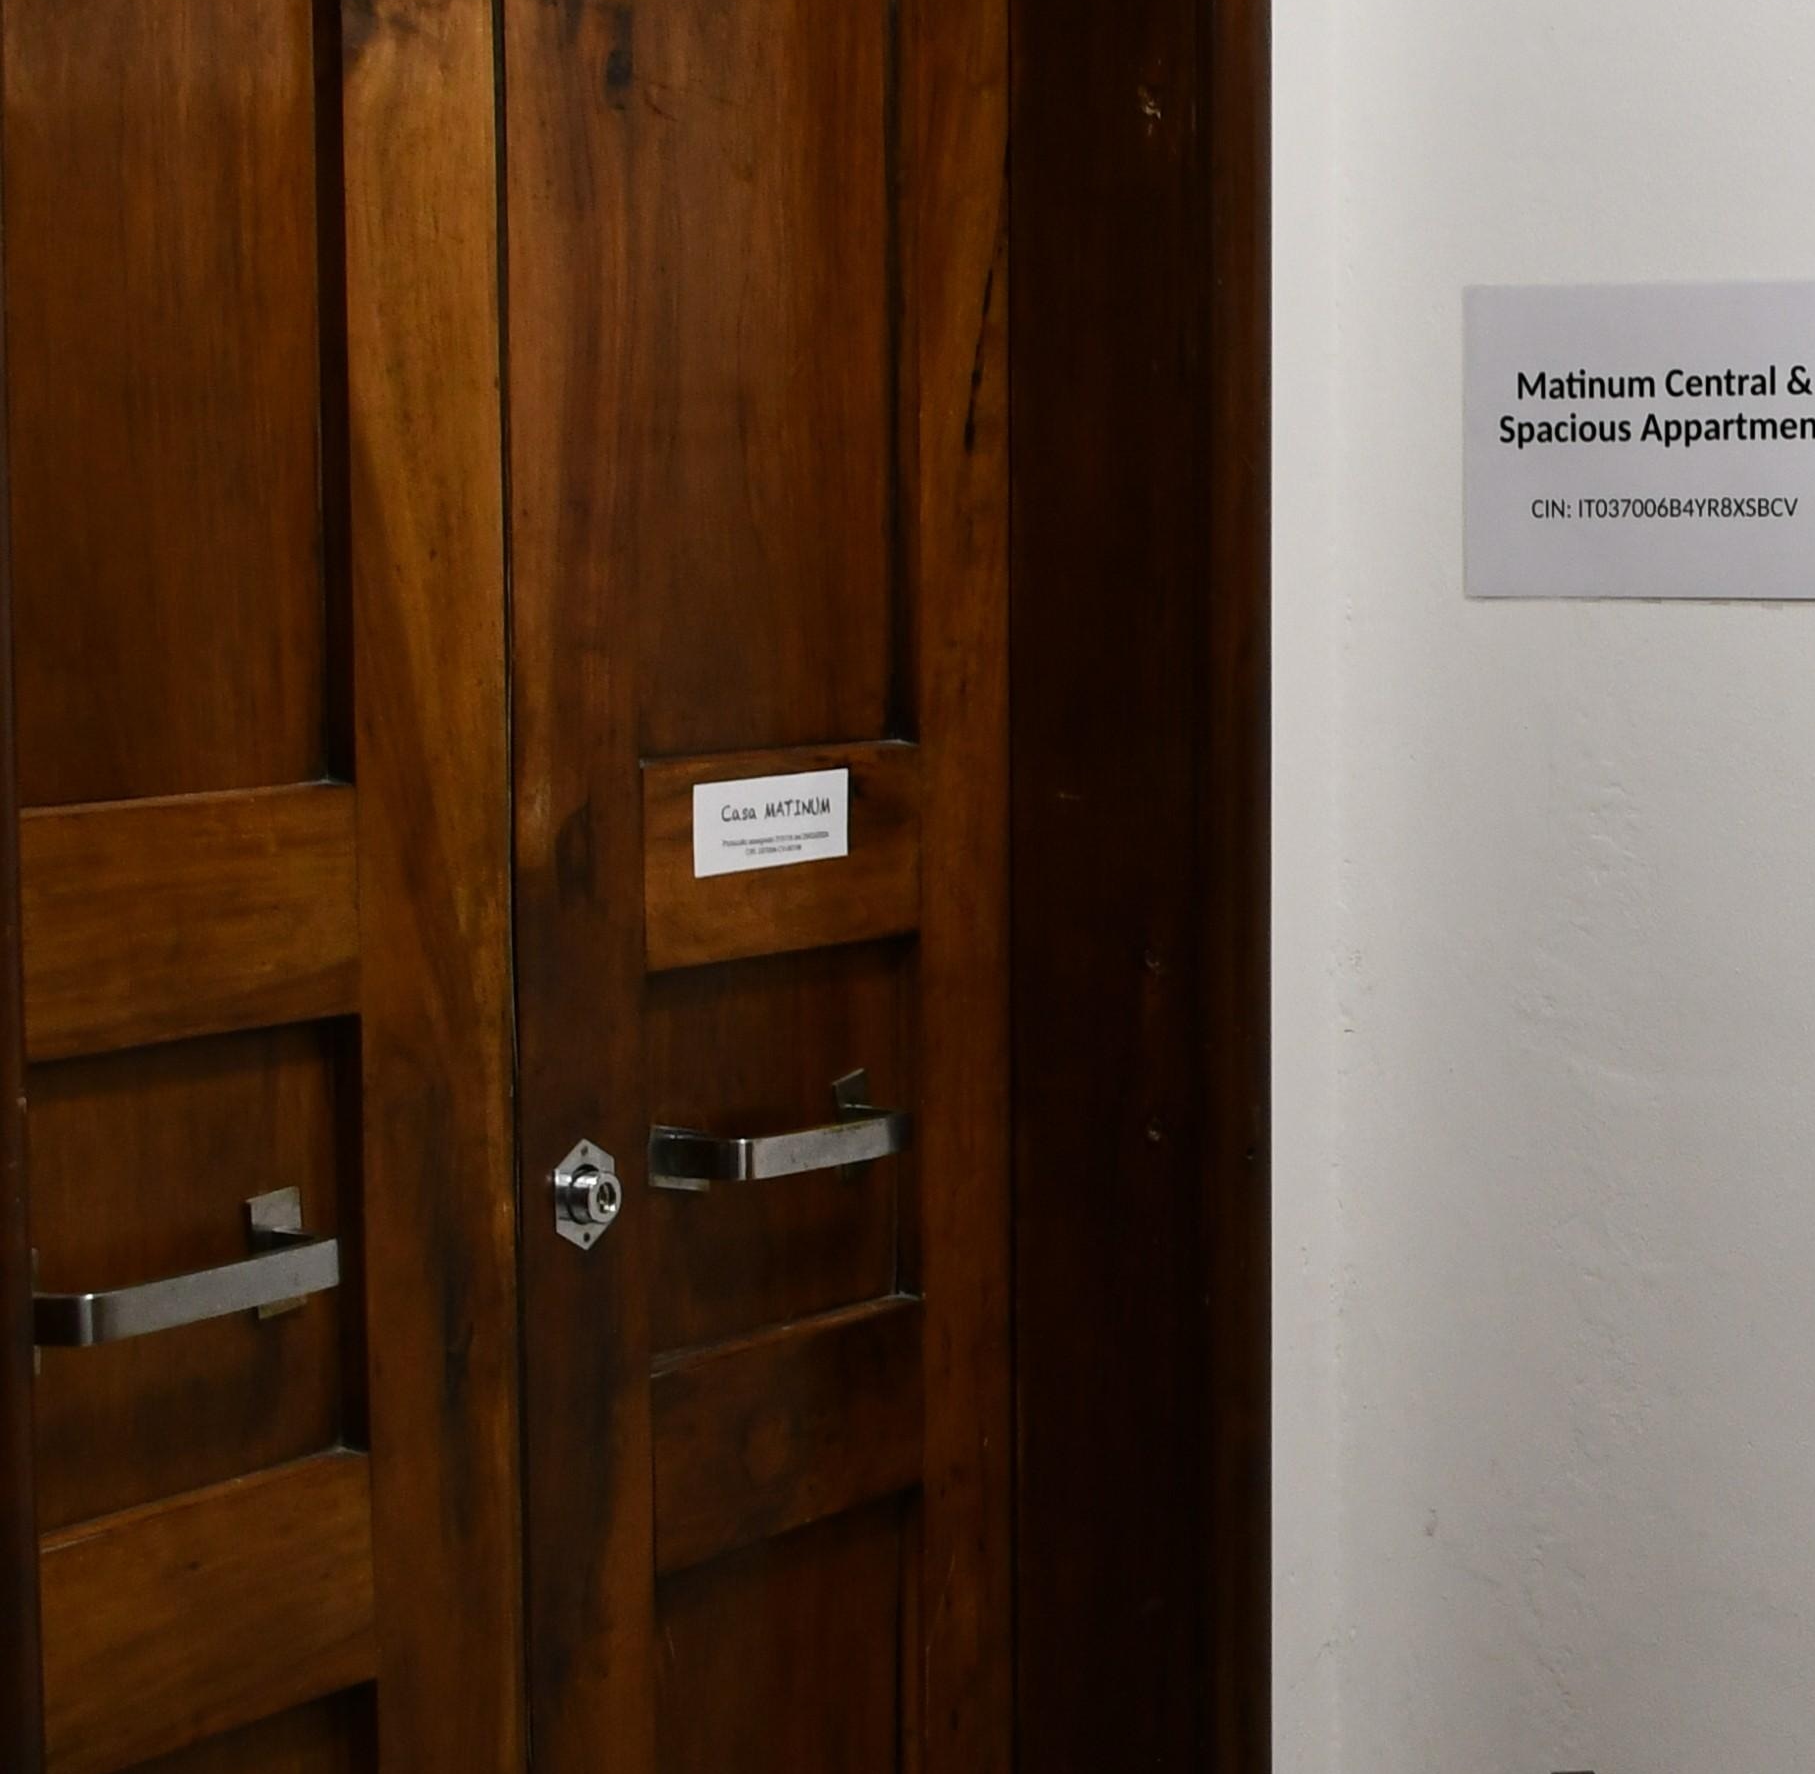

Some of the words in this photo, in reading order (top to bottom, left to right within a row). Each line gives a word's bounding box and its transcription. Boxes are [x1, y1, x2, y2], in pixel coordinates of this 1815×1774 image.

[1517, 369, 1655, 400] Matinum
[1665, 364, 1776, 397] Central
[1786, 365, 1813, 396] &
[1499, 413, 1631, 449] Spacious
[1531, 499, 1572, 519] CIN:
[1578, 497, 1798, 518] IT037006B4YR8XSBCV
[721, 804, 757, 822] Casa
[764, 796, 831, 819] MATINUM
